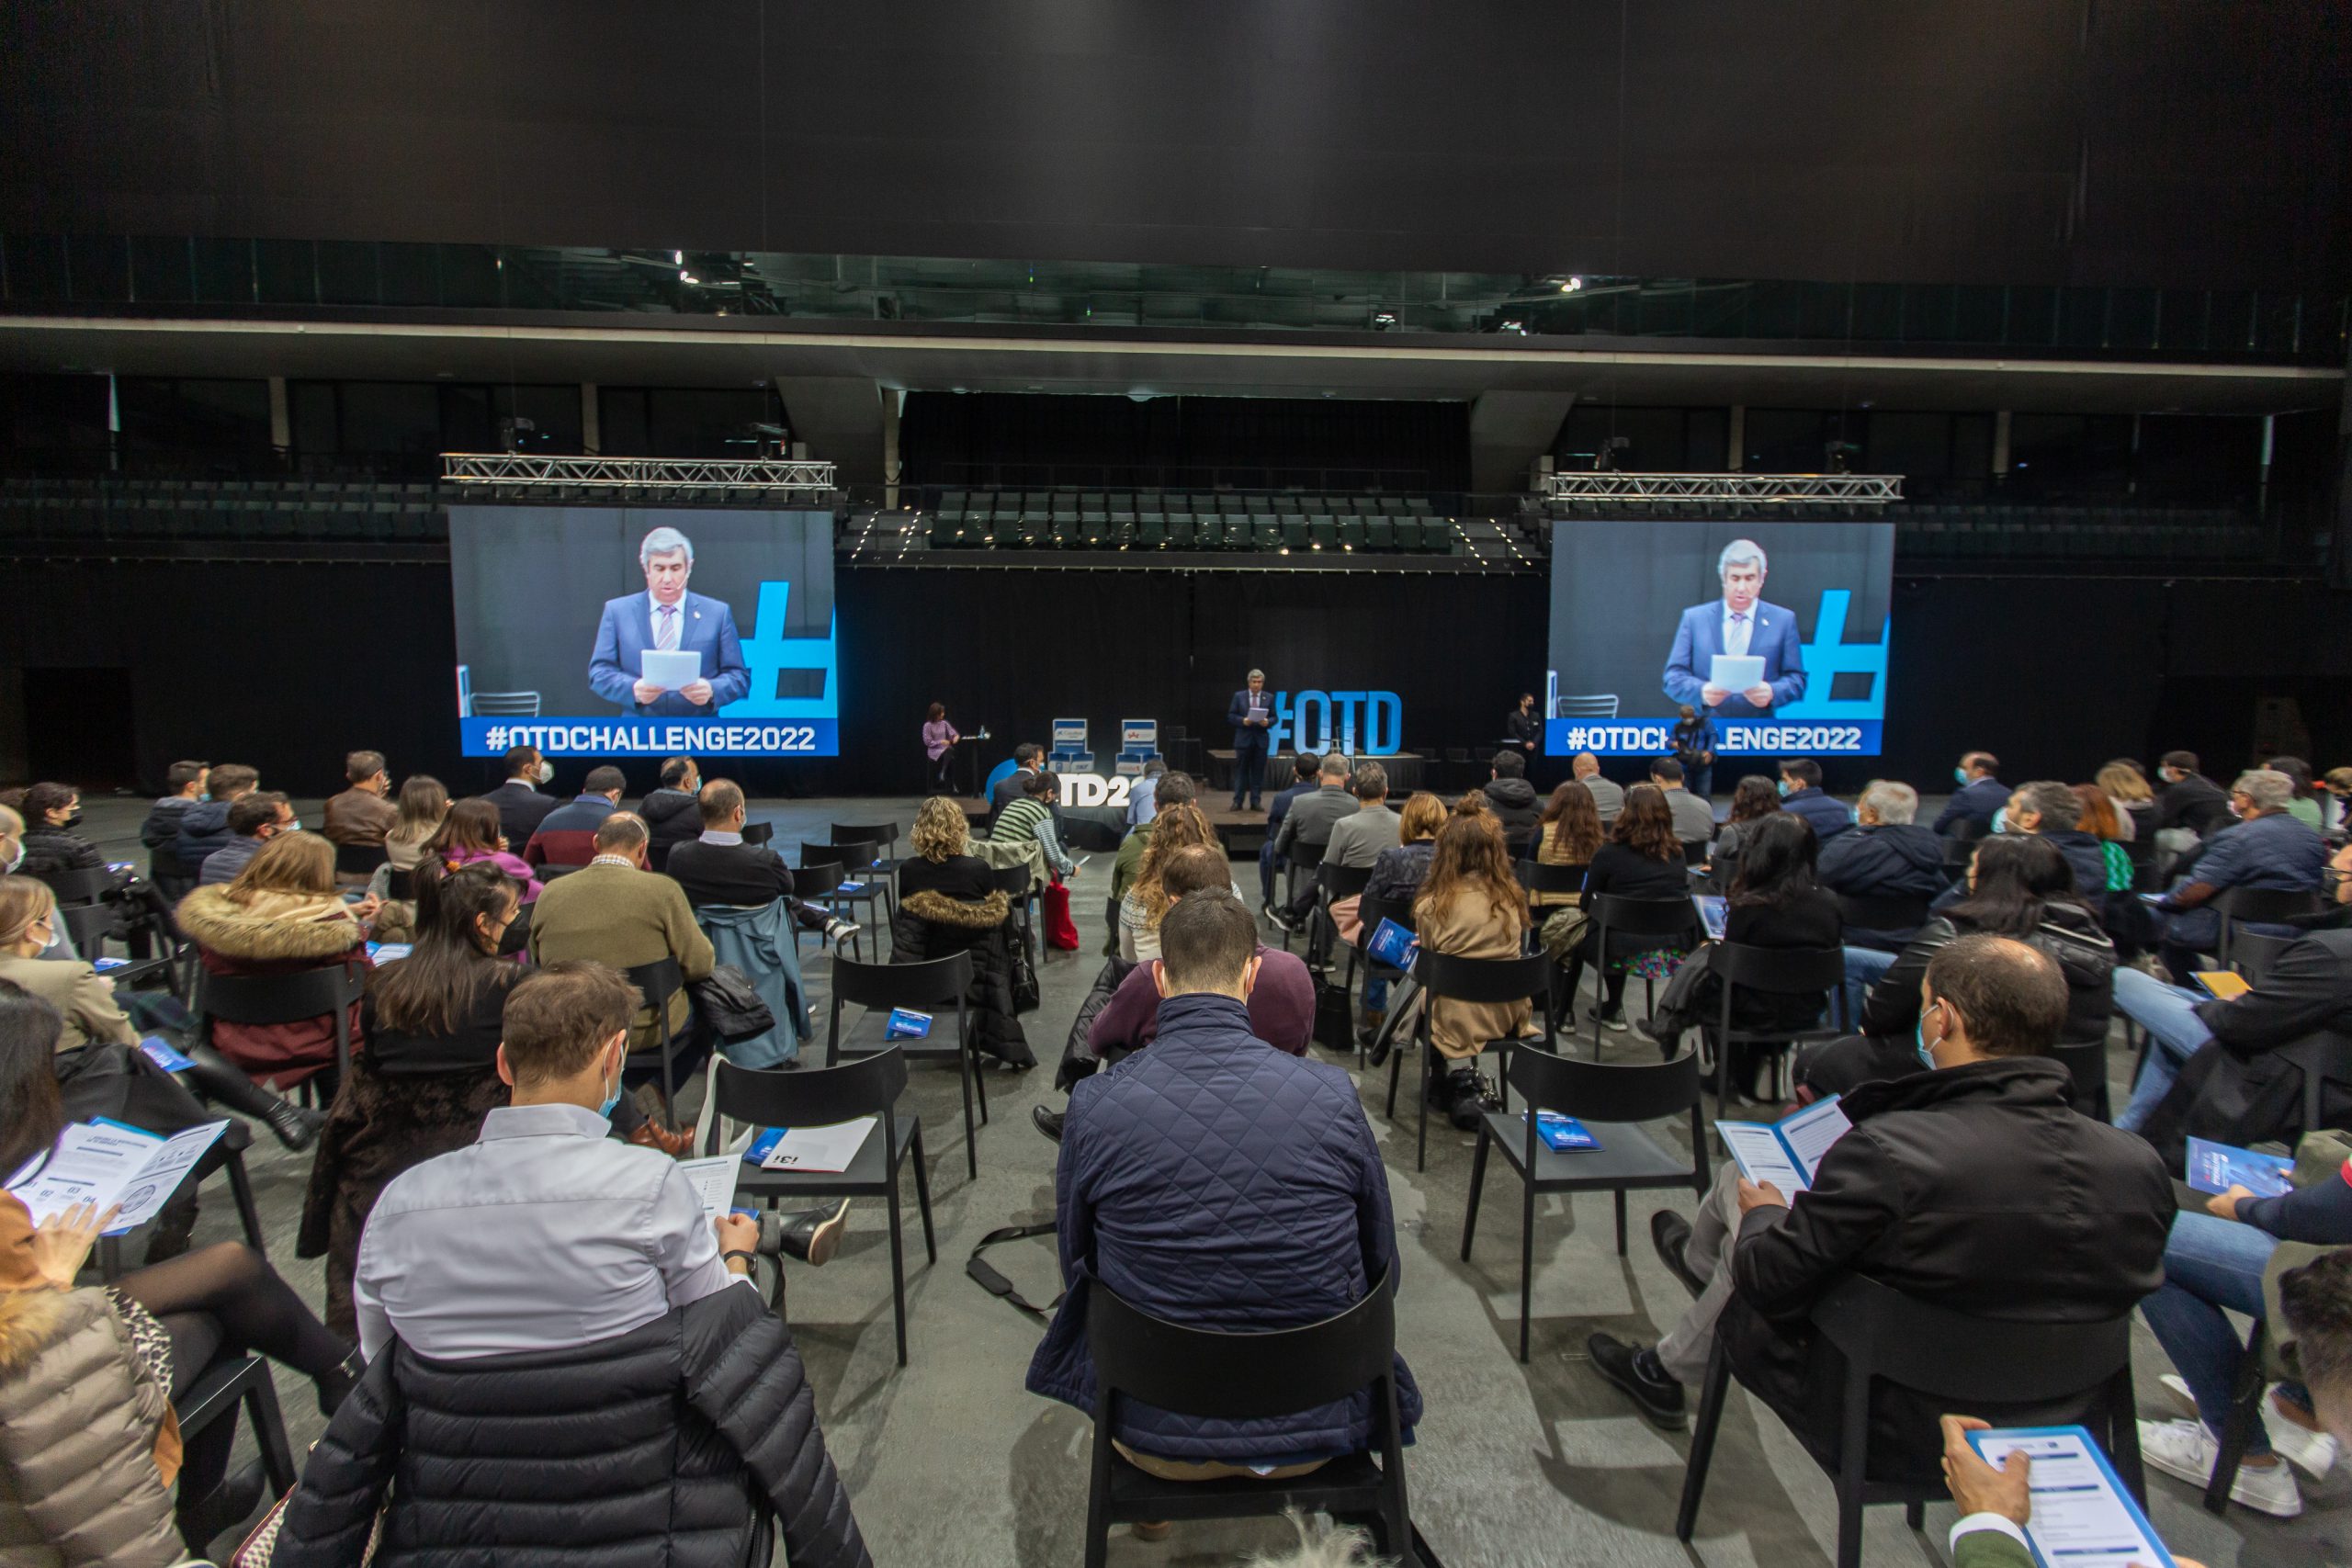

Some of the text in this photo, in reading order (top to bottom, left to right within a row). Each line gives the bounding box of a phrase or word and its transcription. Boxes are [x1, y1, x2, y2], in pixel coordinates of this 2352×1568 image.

[486, 726, 816, 750] #OTDCHALLENGE2022
[1567, 727, 1861, 750] #OTDCHENGE2022
[1056, 773, 1146, 807] TD2
